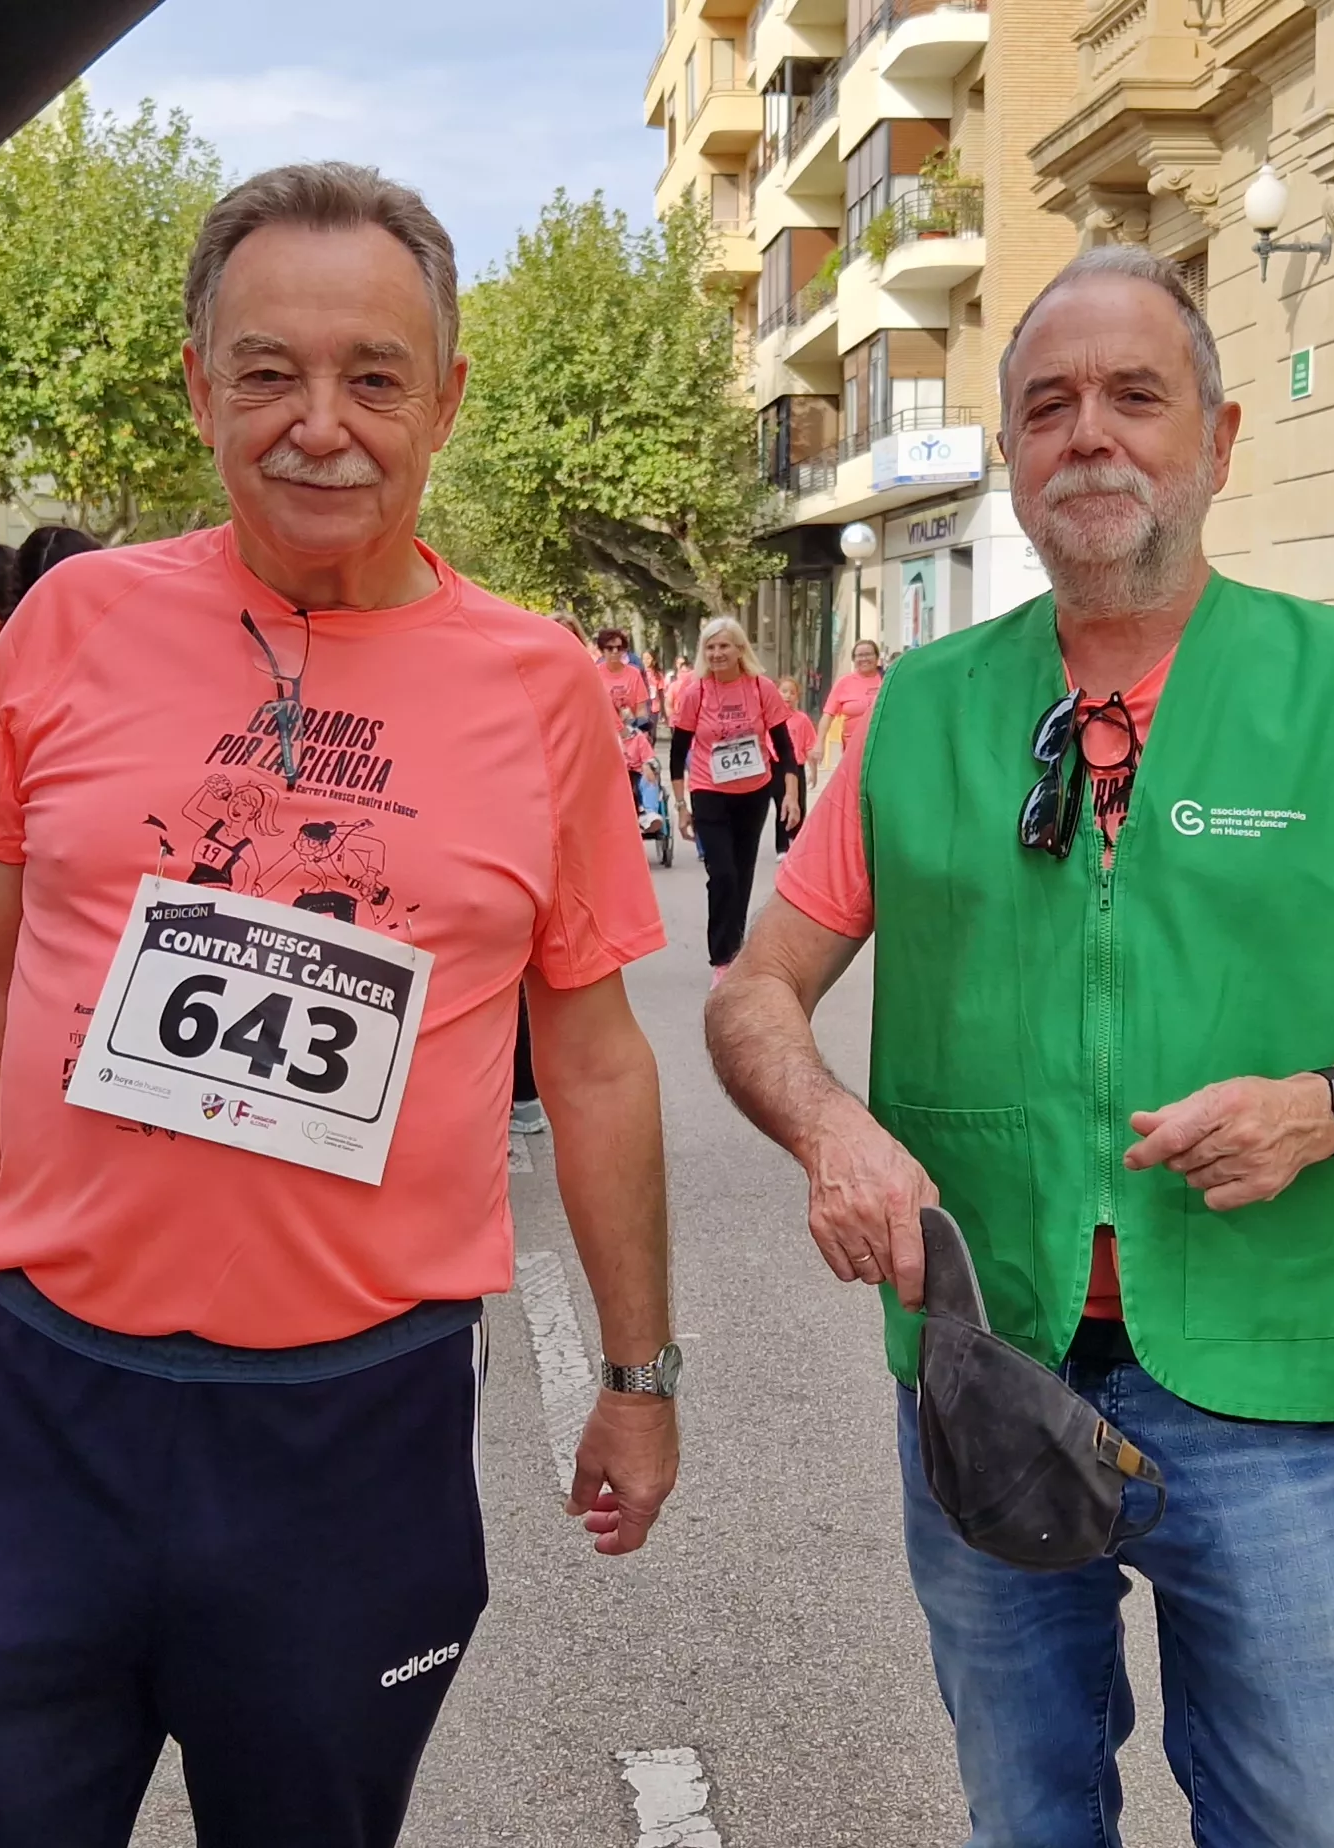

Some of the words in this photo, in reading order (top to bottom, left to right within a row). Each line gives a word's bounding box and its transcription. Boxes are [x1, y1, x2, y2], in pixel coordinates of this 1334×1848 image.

[906, 511, 959, 545] VITALDENT
[205, 733, 264, 766] POR
[295, 745, 394, 794] CIENCIA
[720, 751, 753, 770] 642
[295, 784, 327, 798] Carrera
[329, 788, 356, 804] Huesca
[357, 795, 383, 811] contra
[384, 800, 392, 812] el
[1210, 807, 1262, 817] asociación
[1263, 809, 1307, 821] española
[1210, 816, 1242, 826] contra
[1243, 817, 1253, 826] el
[1254, 819, 1288, 829] cáncer
[1210, 827, 1223, 835] en
[1224, 827, 1261, 838] Huesca
[202, 844, 221, 863] 19
[151, 909, 163, 920] XI
[164, 905, 209, 920] EDICIÓN
[246, 926, 322, 960] HUESCA
[158, 928, 258, 970] CONTRA
[264, 952, 293, 979] EL
[300, 964, 396, 1011] CÁNCER
[158, 973, 359, 1095] 643
[380, 1642, 460, 1688] adidas
